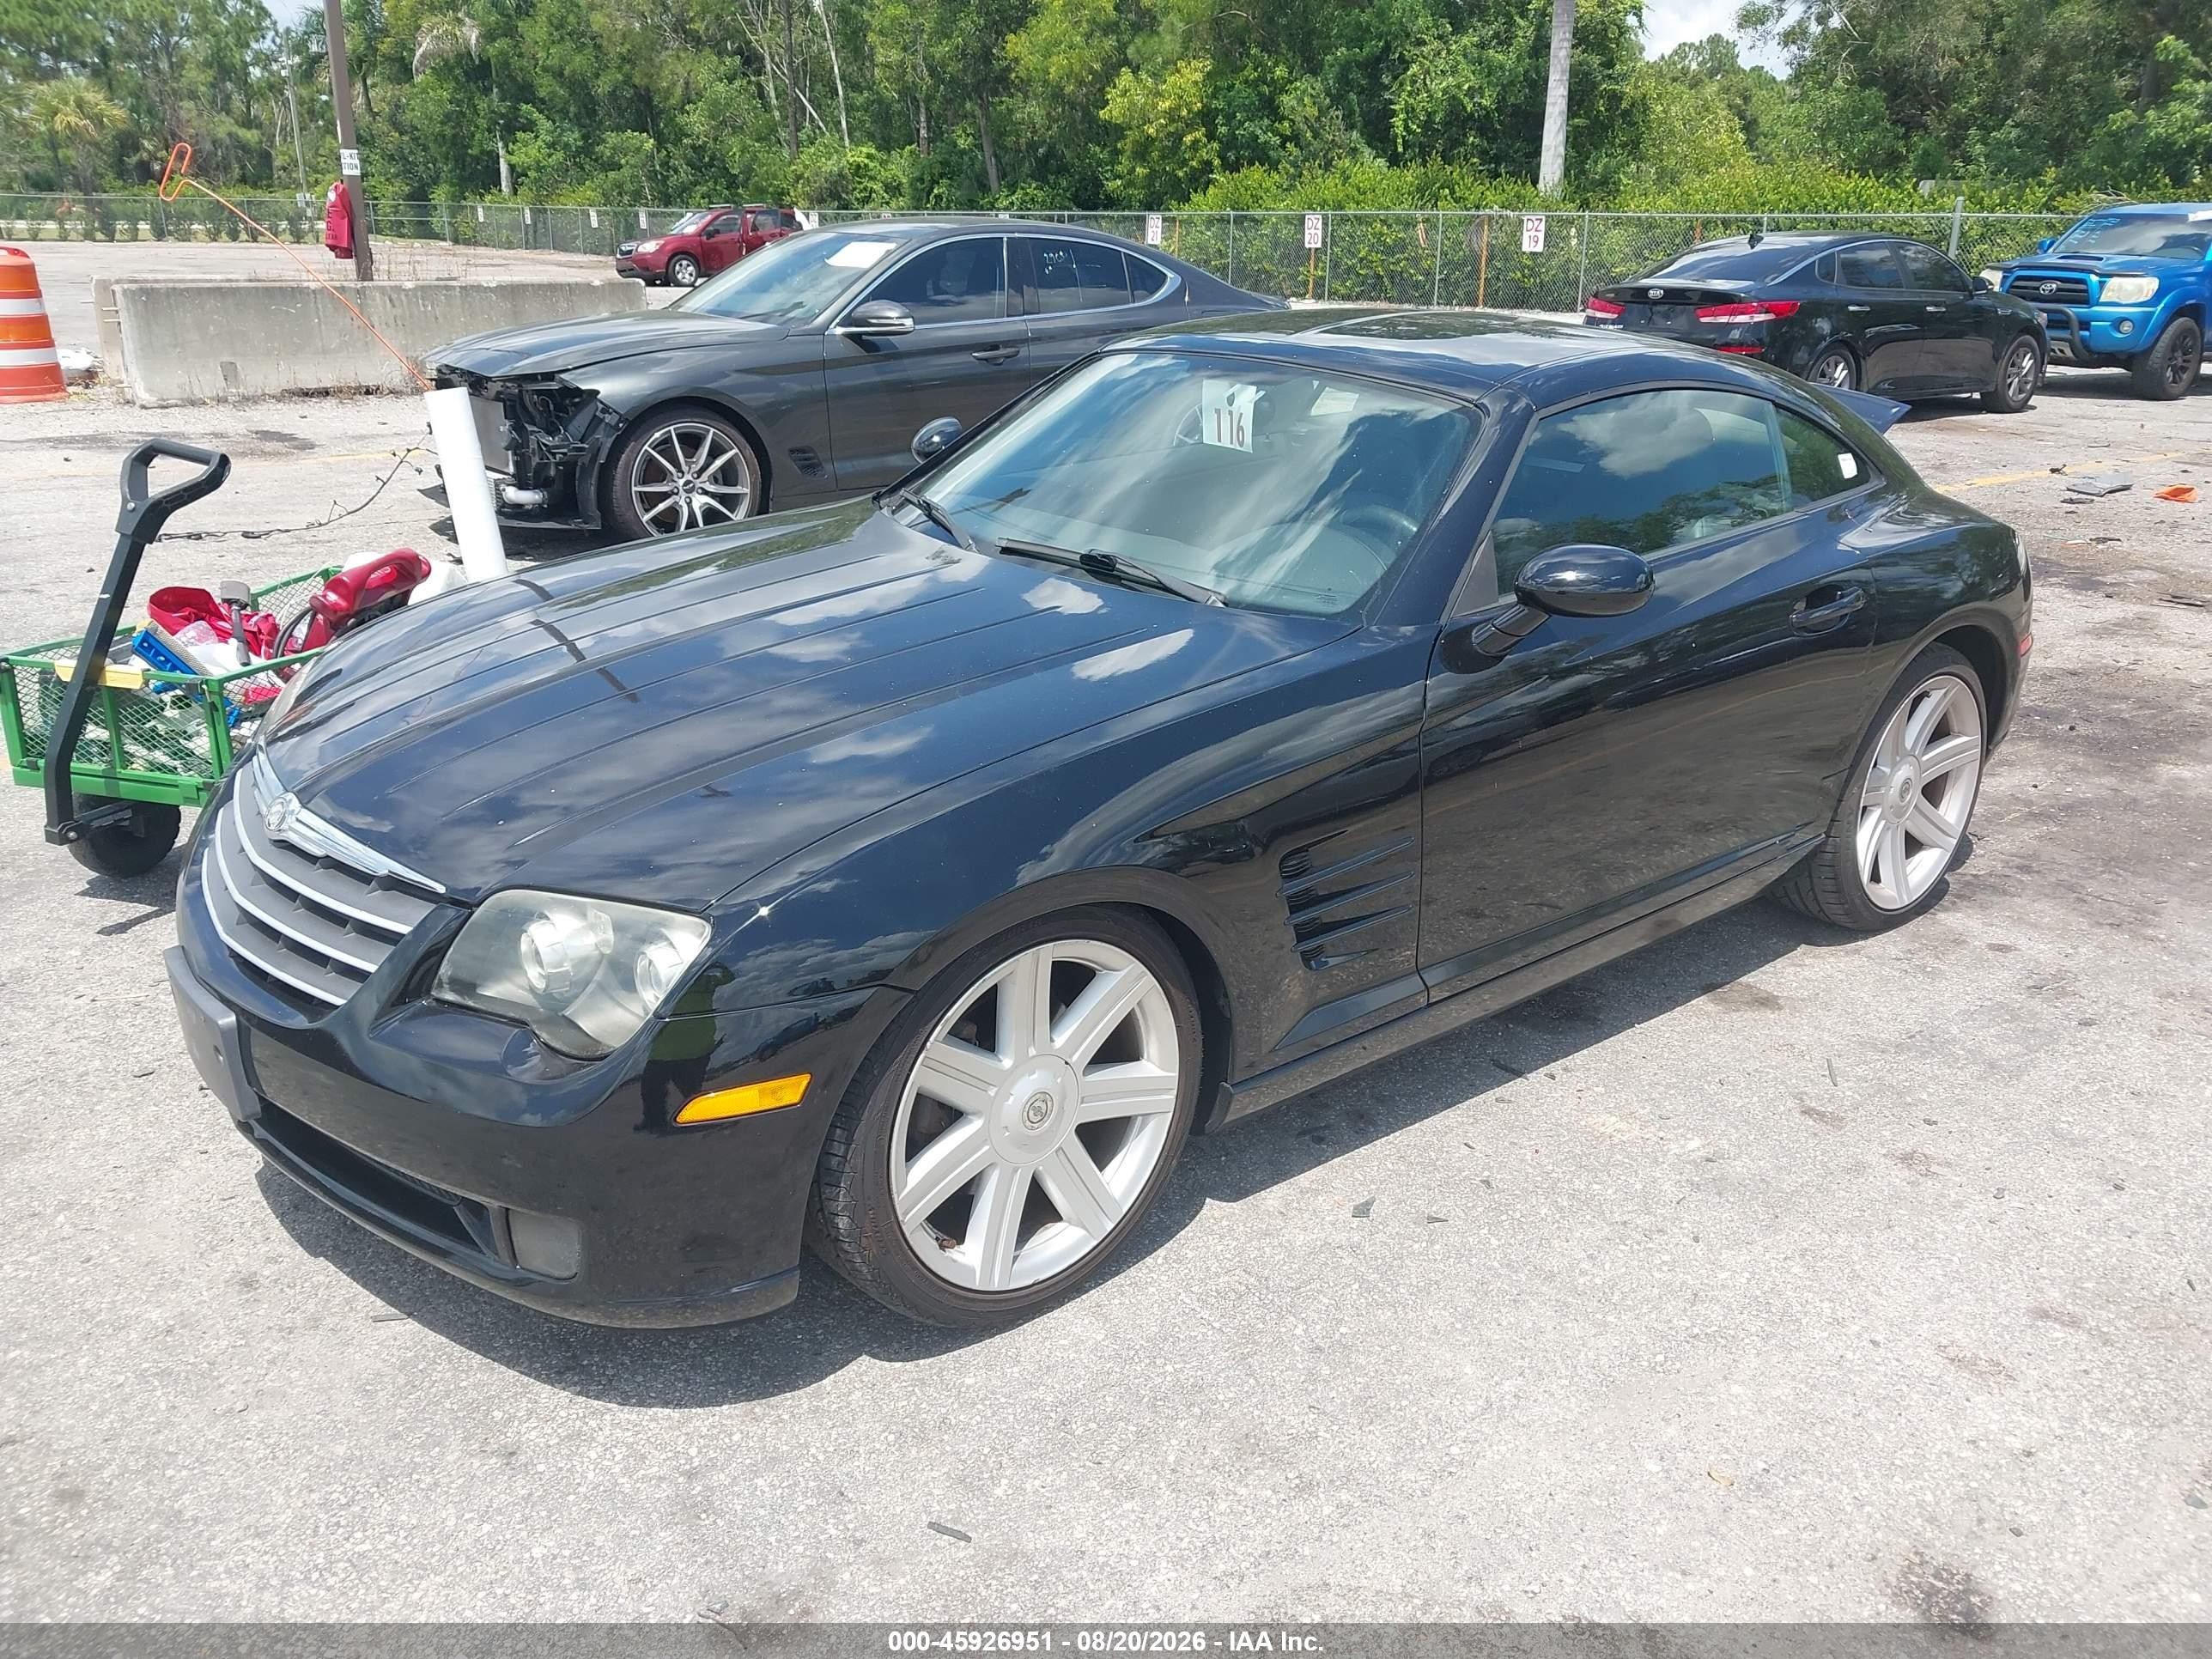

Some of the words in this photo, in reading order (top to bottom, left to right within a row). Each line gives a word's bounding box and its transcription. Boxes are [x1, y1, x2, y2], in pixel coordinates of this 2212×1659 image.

[1149, 216, 1161, 228] DZ
[1306, 217, 1320, 230] DZ
[1525, 217, 1543, 232] DZ
[1151, 230, 1158, 241] 21
[1307, 232, 1319, 245] 20
[1528, 234, 1540, 248] 19
[1214, 408, 1245, 447] 116
